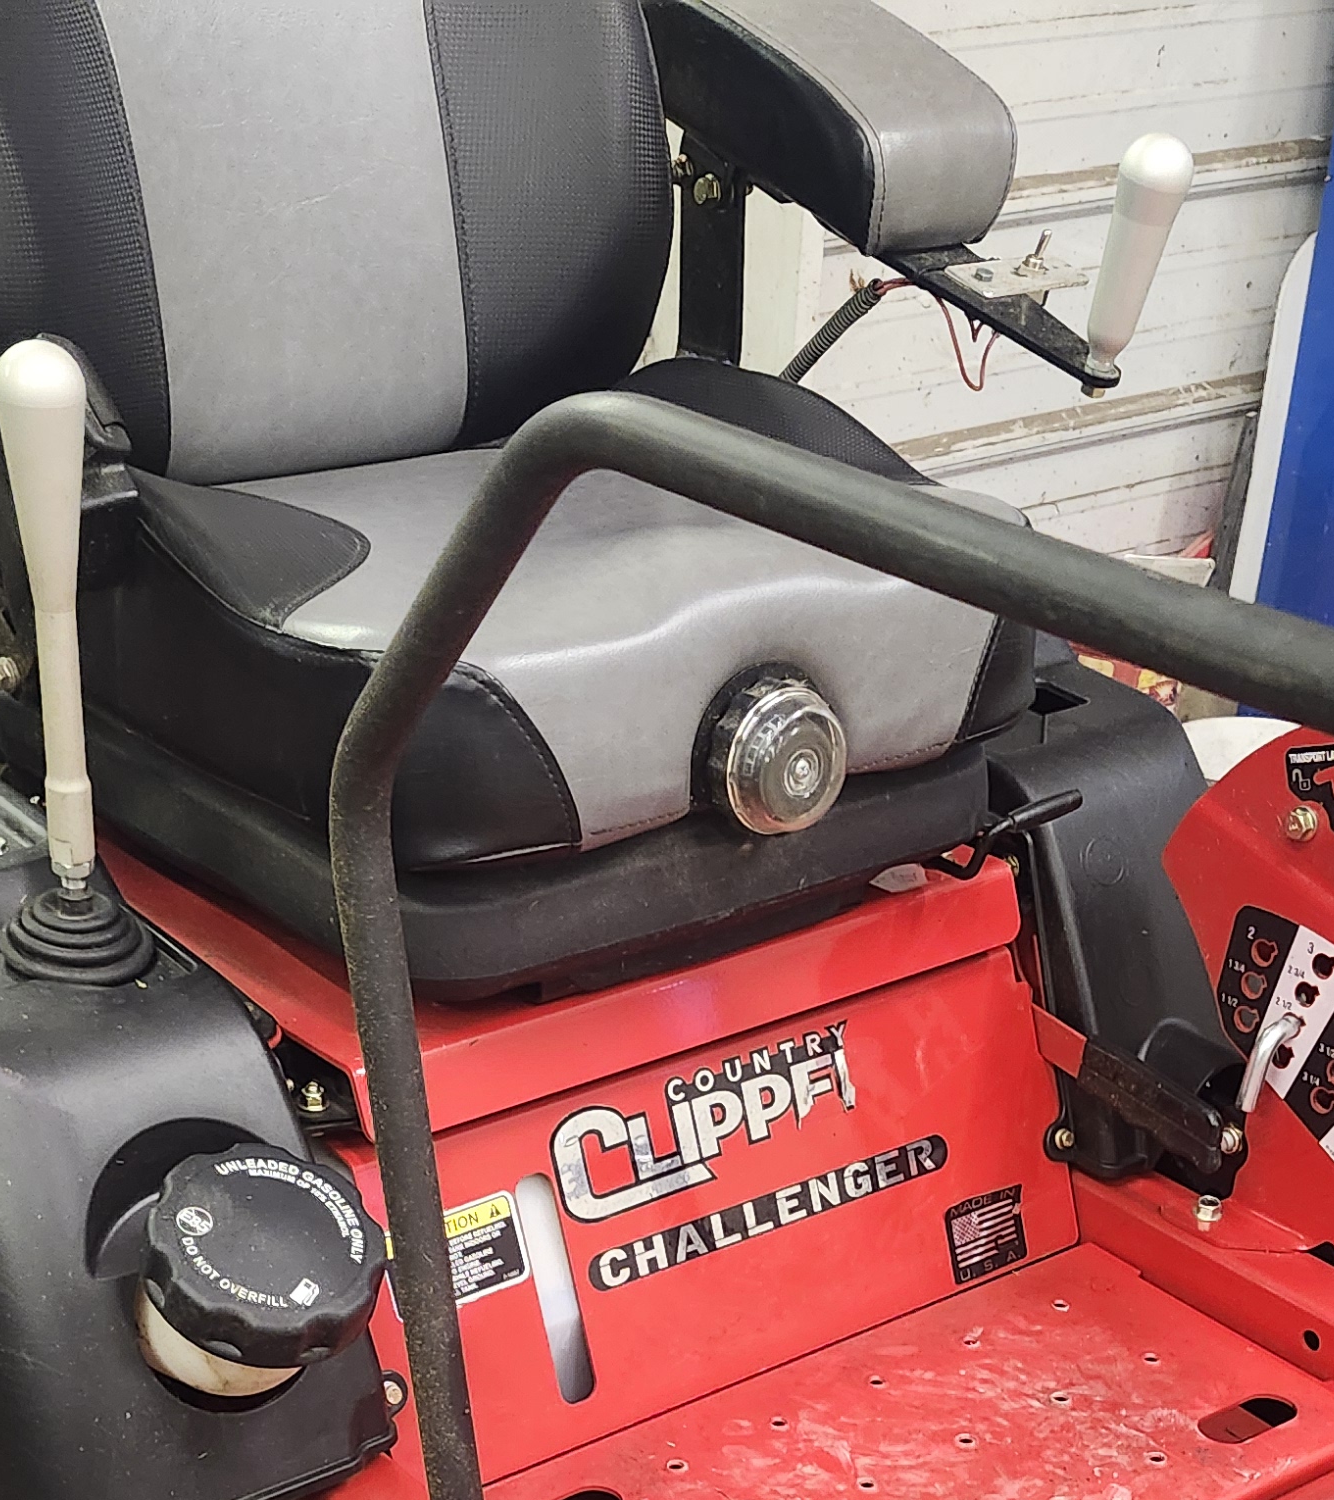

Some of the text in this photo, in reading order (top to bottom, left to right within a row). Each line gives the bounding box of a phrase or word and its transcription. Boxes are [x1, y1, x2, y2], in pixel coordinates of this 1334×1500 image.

[1247, 926, 1255, 939] 2
[1307, 942, 1314, 954] 3
[667, 1023, 847, 1101] COUNTRY
[249, 1168, 296, 1184] MAXIMUM
[296, 1179, 311, 1190] OF
[214, 1158, 363, 1264] UNLEADED GASOLINE ONLY
[599, 1139, 936, 1287] CHALLENGER
[950, 1188, 1015, 1218] MADE IN
[179, 1208, 211, 1233] E85
[446, 1211, 479, 1234] TION
[181, 1236, 289, 1308] DO NOT OVERFILL
